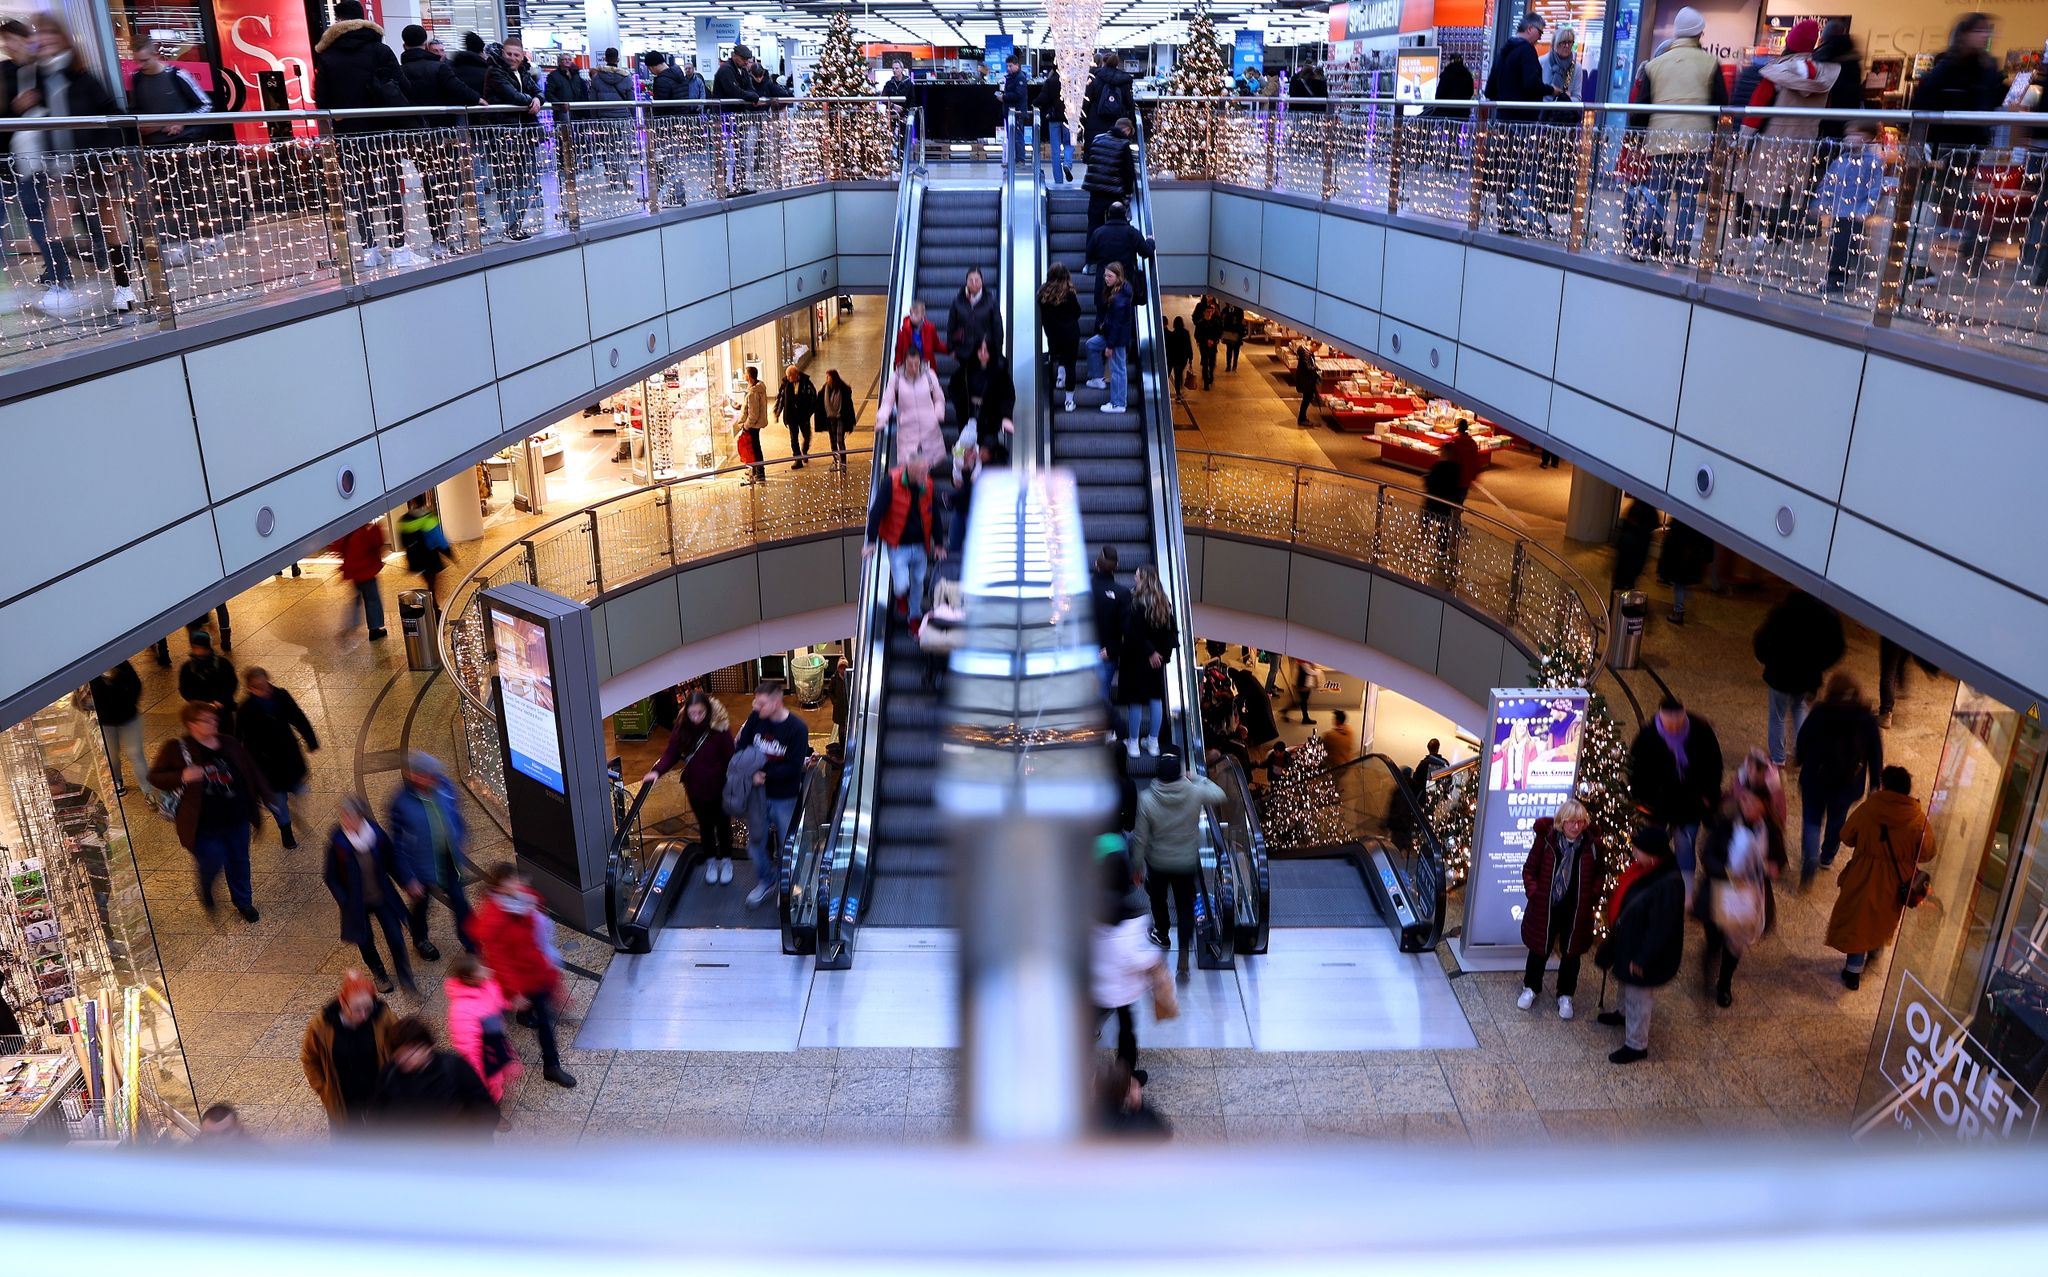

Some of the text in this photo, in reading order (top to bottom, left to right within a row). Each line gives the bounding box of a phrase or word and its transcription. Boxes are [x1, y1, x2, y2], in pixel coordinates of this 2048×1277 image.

[1349, 0, 1399, 33] SPIELWAREN
[1323, 680, 1340, 689] dm
[1508, 793, 1568, 805] ECHTER
[1509, 806, 1558, 817] WINTE
[1906, 1001, 2023, 1140] OUTLET
